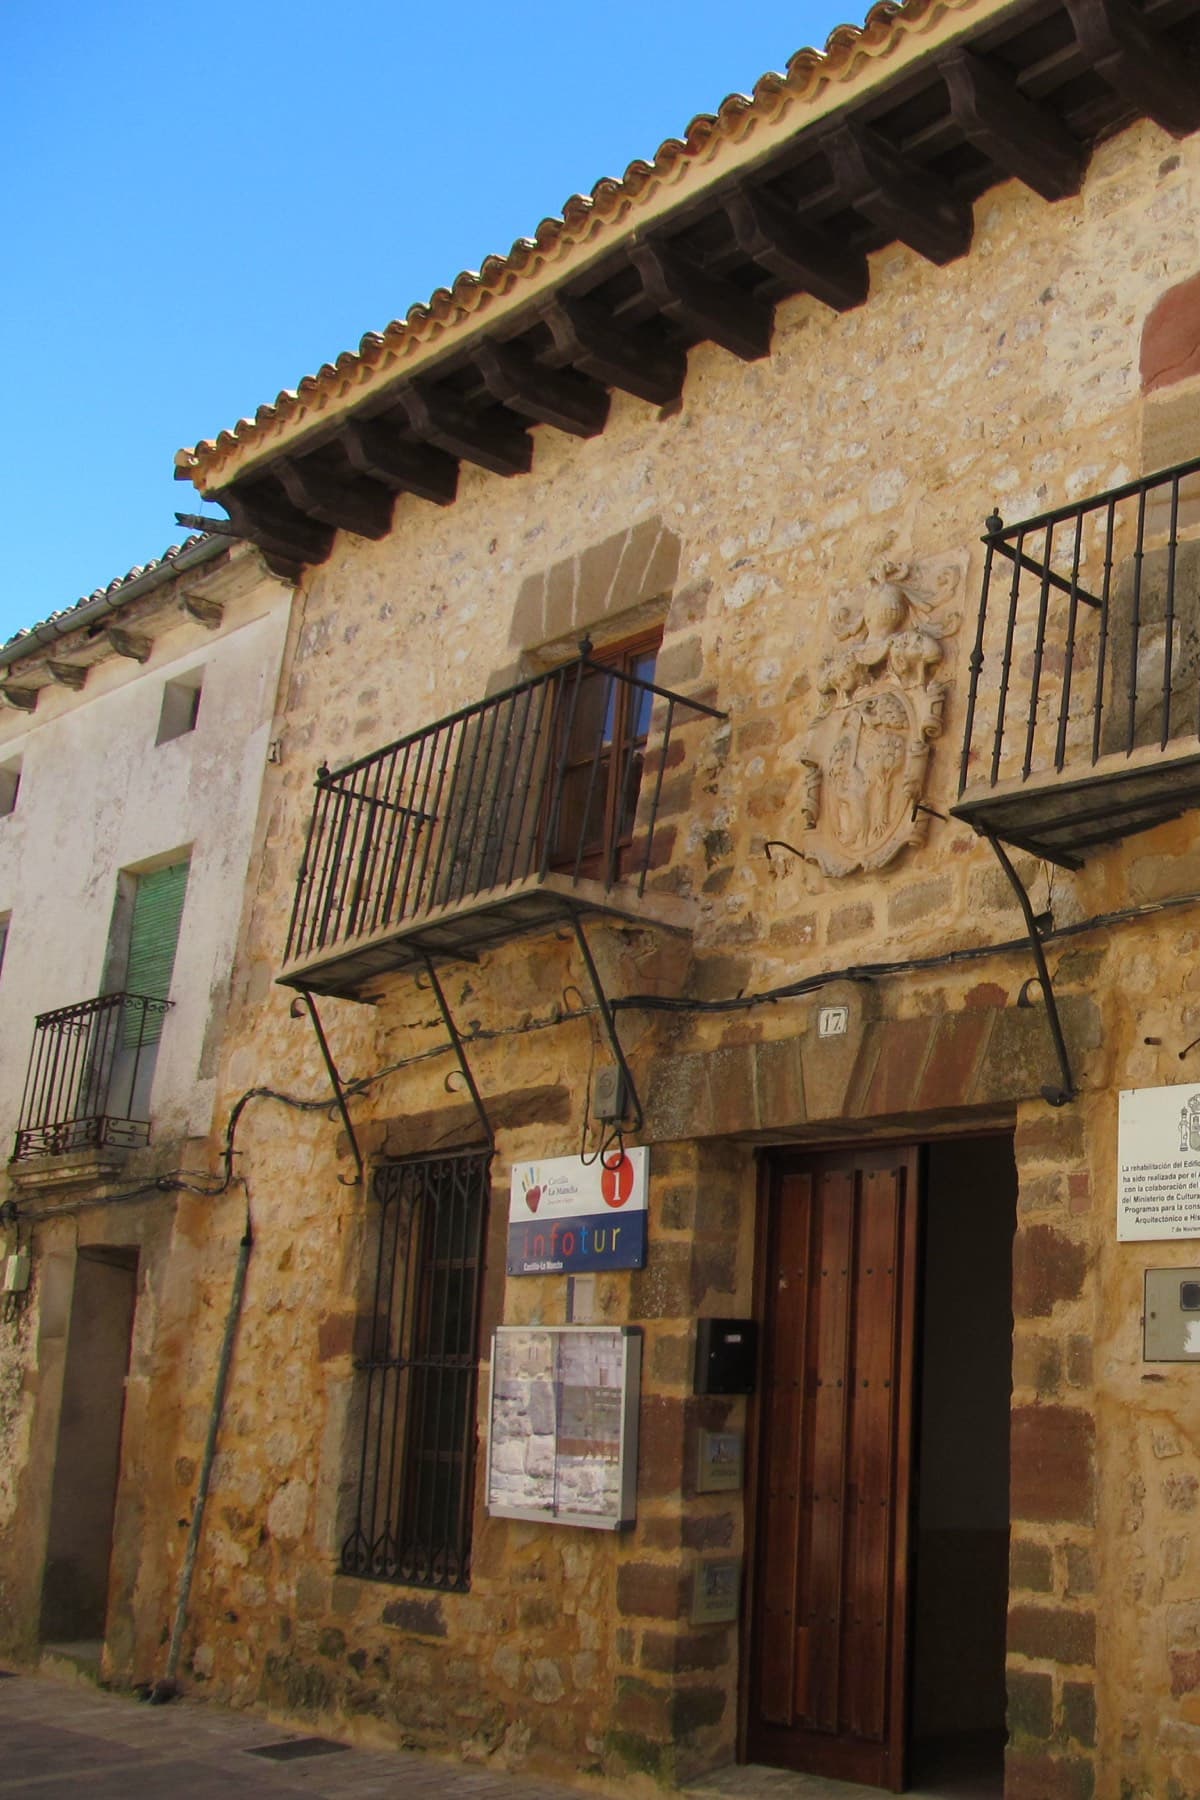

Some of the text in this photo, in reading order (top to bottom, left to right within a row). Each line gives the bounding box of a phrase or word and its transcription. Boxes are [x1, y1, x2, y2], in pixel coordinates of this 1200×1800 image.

[1131, 1162, 1171, 1171] rehabilitación
[1148, 1173, 1176, 1181] realizada
[1178, 1172, 1189, 1180] por
[1145, 1182, 1187, 1192] colaboración
[1133, 1194, 1165, 1202] Ministerio
[1124, 1206, 1159, 1214] Programas
[1161, 1205, 1175, 1213] para
[1135, 1214, 1183, 1224] Arquitectónico
